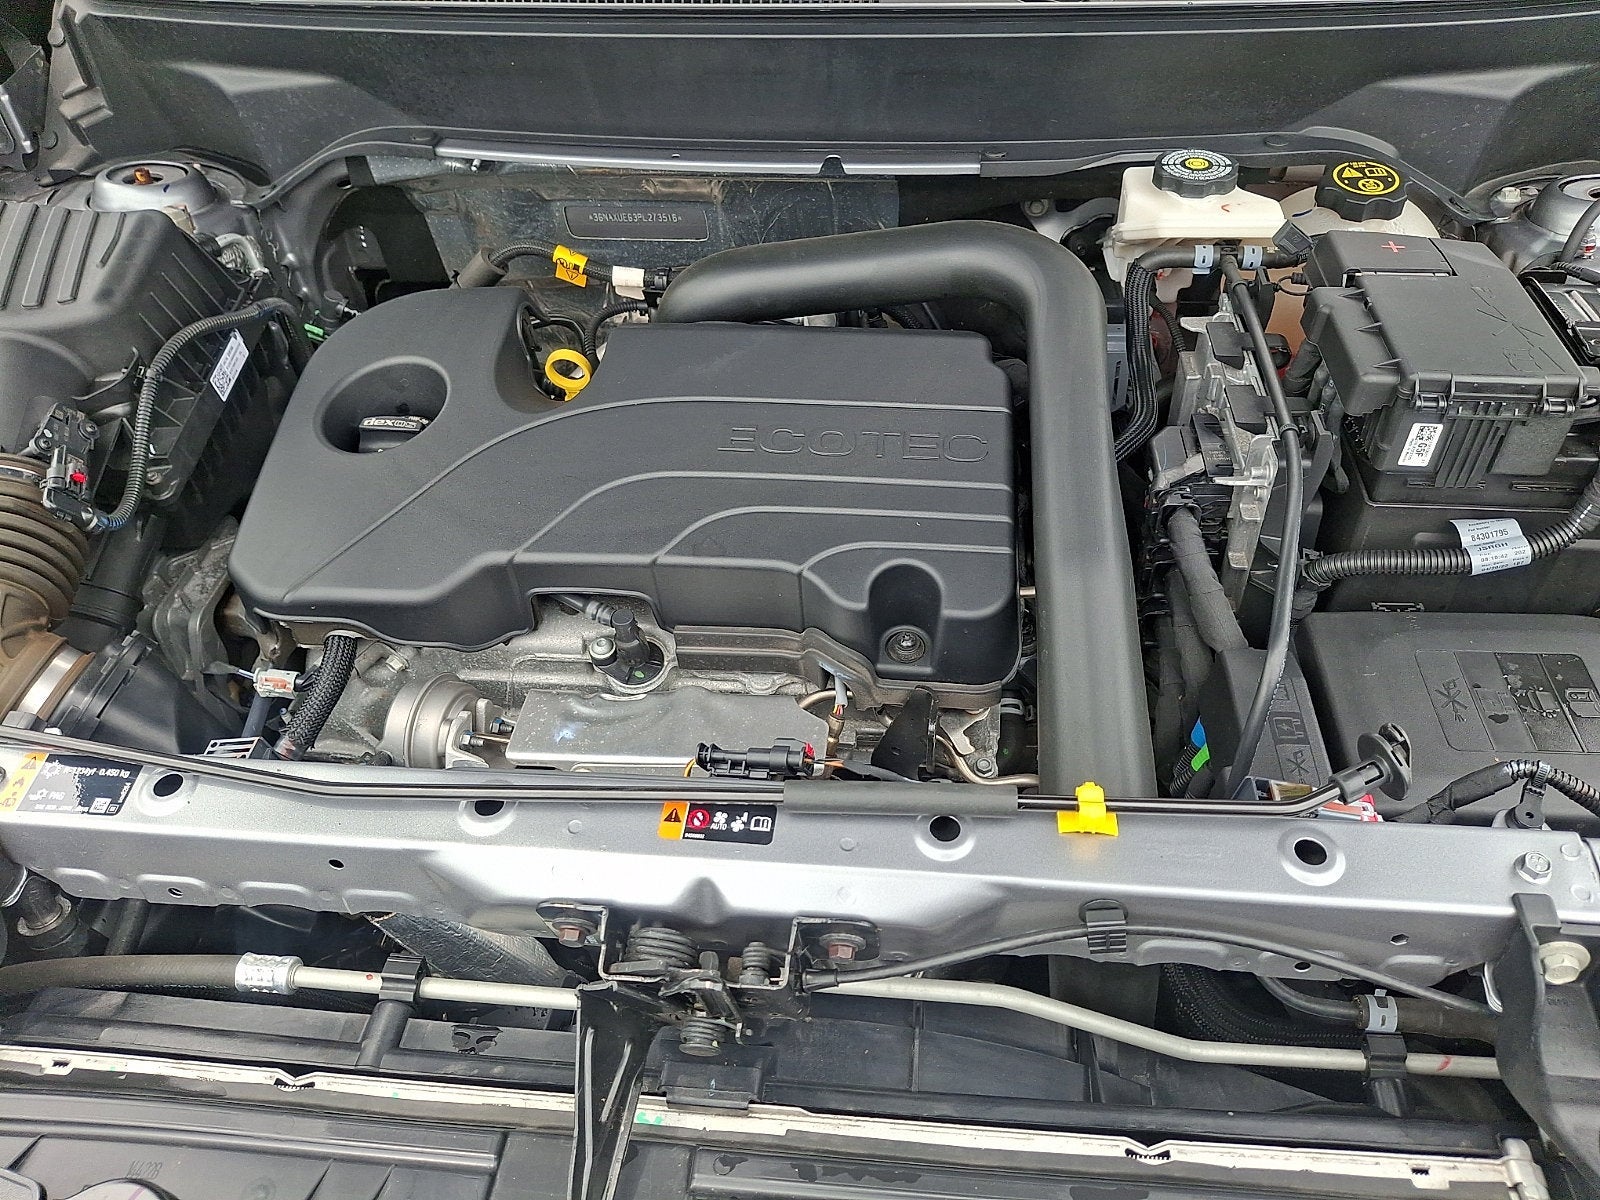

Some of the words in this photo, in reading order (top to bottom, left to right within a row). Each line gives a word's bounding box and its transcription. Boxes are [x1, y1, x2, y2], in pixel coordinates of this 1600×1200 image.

[363, 418, 417, 429] dexos
[717, 427, 989, 462] ECOTEC
[1470, 528, 1509, 542] 84301795
[710, 822, 728, 831] AUTO
